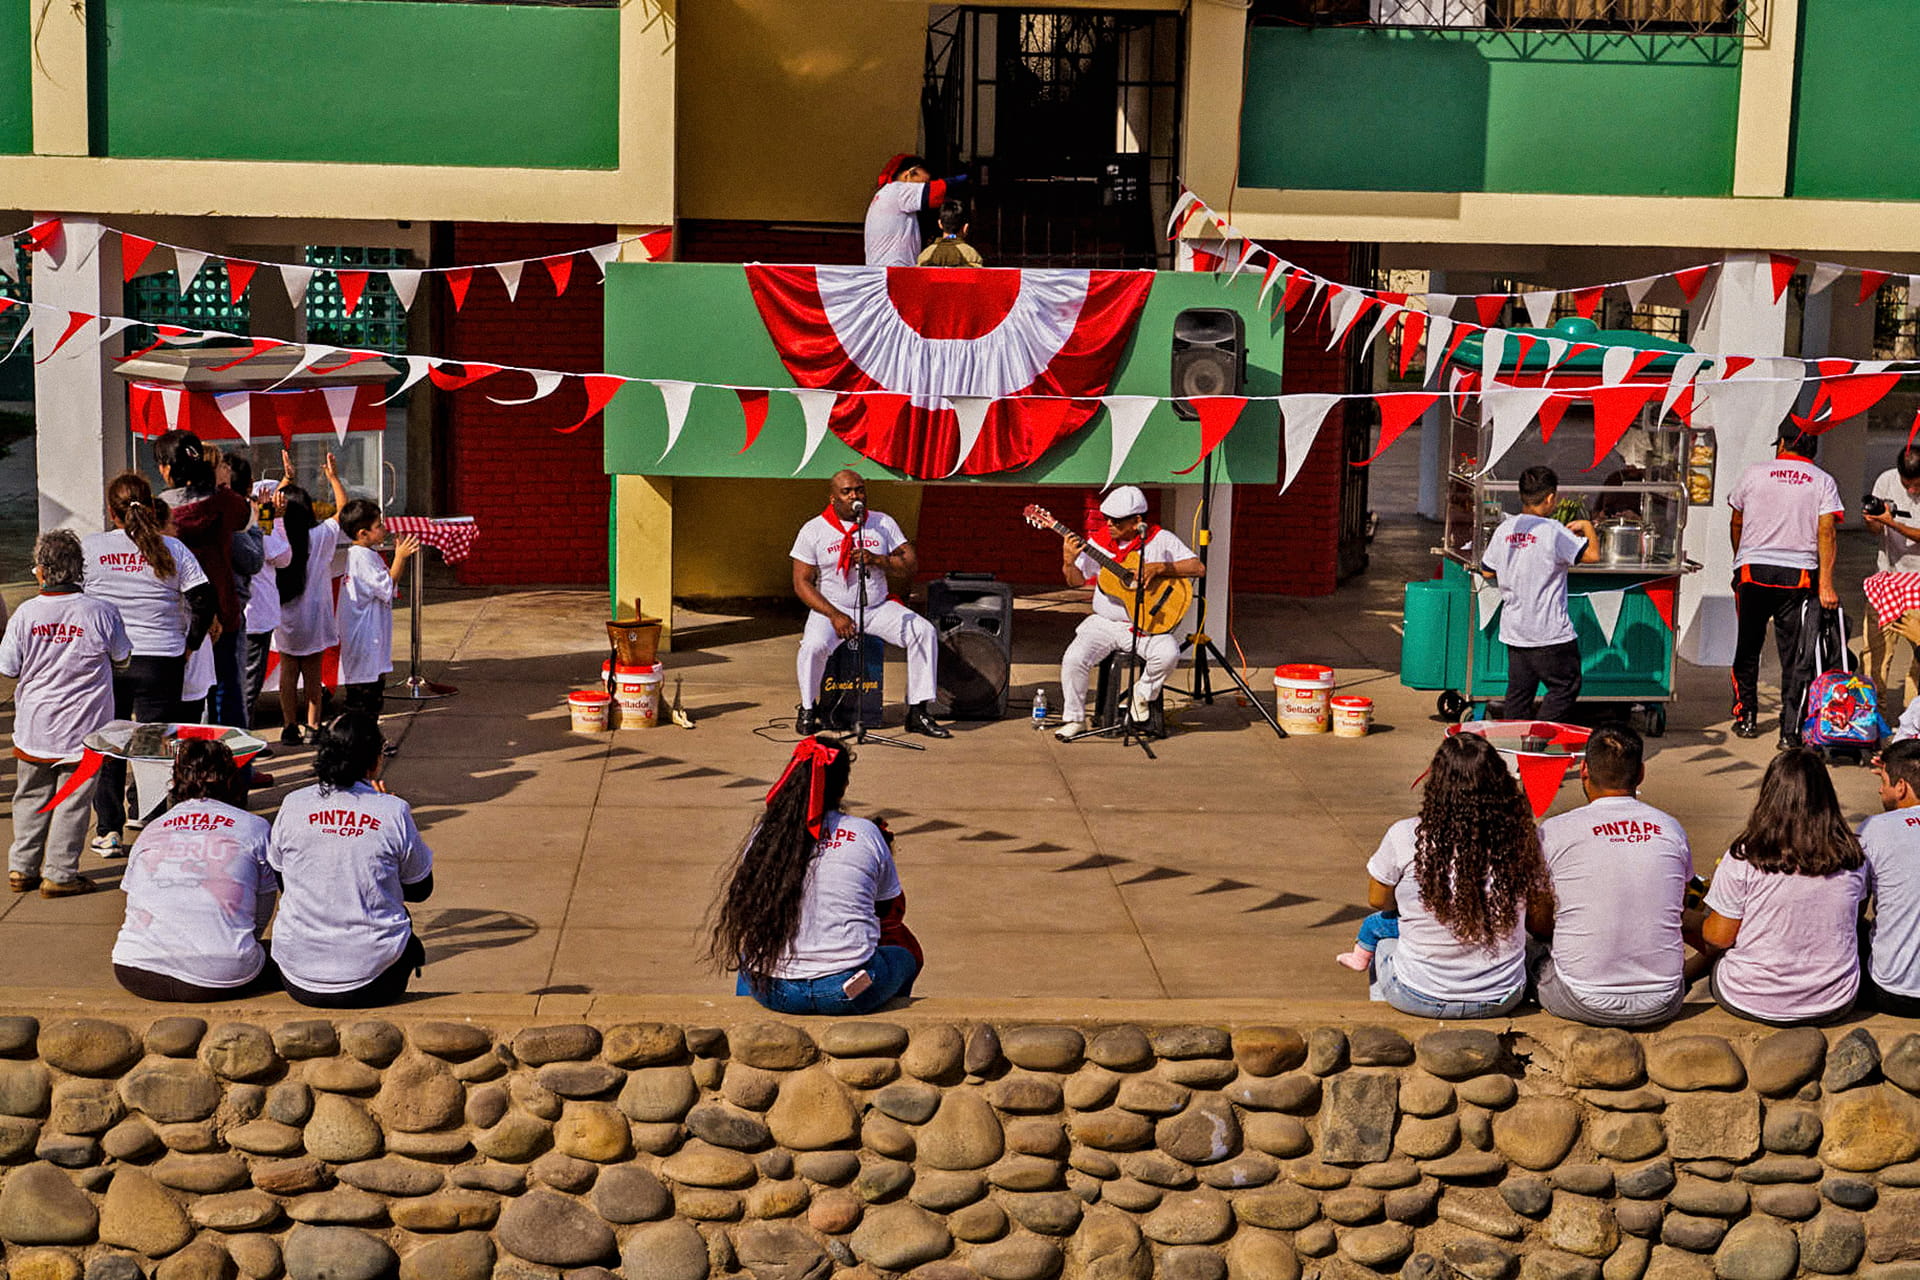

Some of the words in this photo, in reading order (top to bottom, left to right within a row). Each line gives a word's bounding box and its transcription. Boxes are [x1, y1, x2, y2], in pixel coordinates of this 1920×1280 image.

[1770, 470, 1799, 479] PINTA
[100, 553, 137, 566] PINTA
[31, 623, 66, 636] PINTA
[69, 625, 84, 637] PE
[163, 813, 210, 828] PINTA
[213, 815, 236, 828] PE
[309, 809, 356, 827] PINTA
[359, 813, 381, 831] PE
[339, 827, 364, 837] CPP
[836, 828, 856, 842] PE
[1592, 820, 1641, 836] PINTA
[1643, 821, 1662, 835] PE
[1627, 834, 1651, 843] CPP
